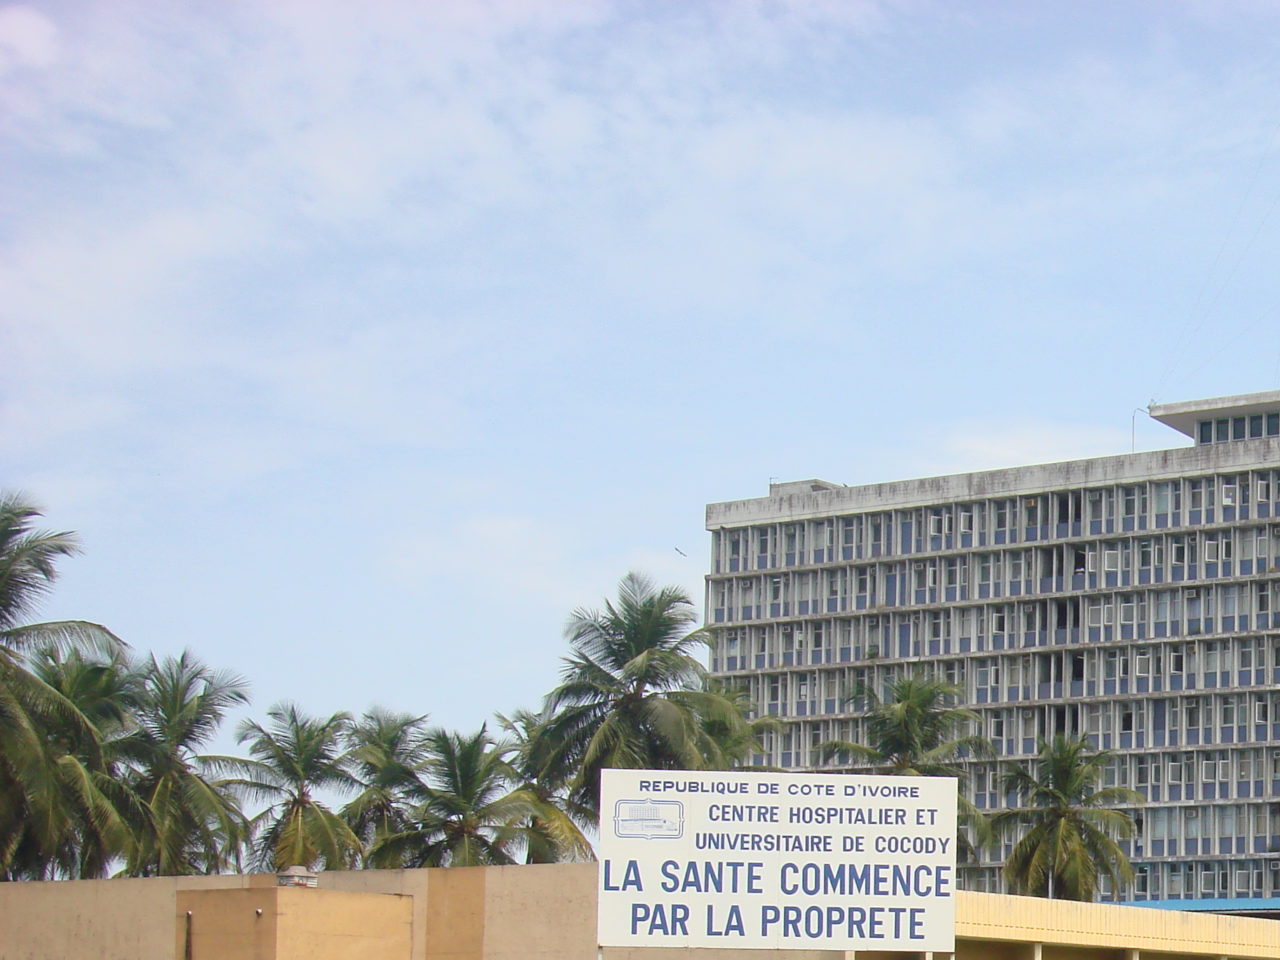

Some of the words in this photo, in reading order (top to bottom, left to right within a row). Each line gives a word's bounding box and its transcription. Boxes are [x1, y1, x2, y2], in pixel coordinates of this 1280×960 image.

[640, 781, 749, 794] REPUBLIQUE
[758, 783, 779, 794] DE
[788, 784, 835, 796] COTE
[845, 785, 919, 797] D'IVOIRE
[709, 805, 779, 823] CENTRE
[790, 807, 906, 825] HOSPITALIER
[917, 809, 937, 825] ET
[696, 833, 832, 852] UNIVERSITAIRE
[843, 836, 864, 852] DE
[876, 836, 949, 854] COCODY
[604, 860, 642, 891] LA
[661, 860, 763, 893] SANTE
[781, 863, 950, 896] COMMENCE
[632, 904, 689, 935] PAR
[707, 905, 745, 936] LA
[762, 906, 925, 939] PROPRETE
